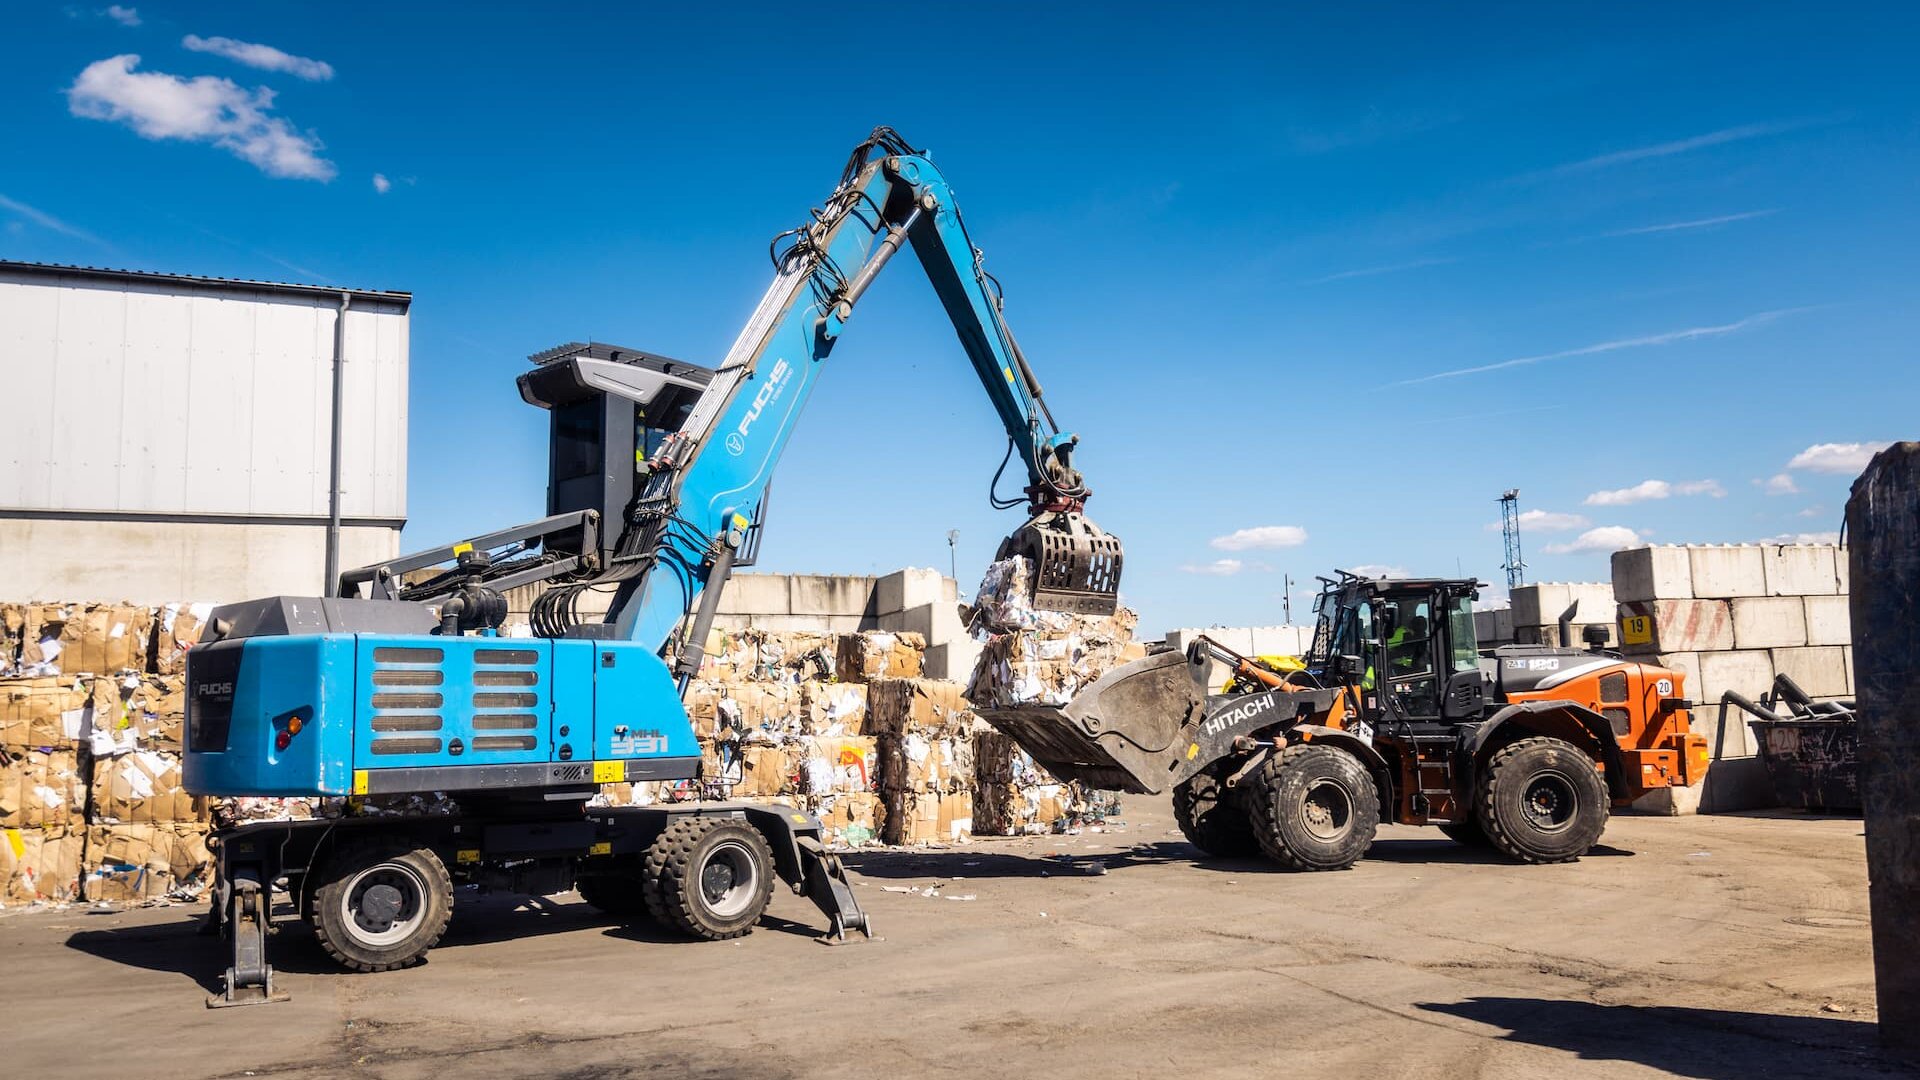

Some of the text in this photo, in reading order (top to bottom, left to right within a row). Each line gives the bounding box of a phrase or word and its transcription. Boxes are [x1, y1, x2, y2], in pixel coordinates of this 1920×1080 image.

[738, 358, 788, 436] FUCHS
[1631, 618, 1643, 633] 19
[199, 682, 233, 696] FUCHS
[1659, 681, 1670, 693] 20
[1205, 693, 1275, 736] HITACHI
[631, 729, 665, 738] MHL
[611, 735, 668, 754] 931
